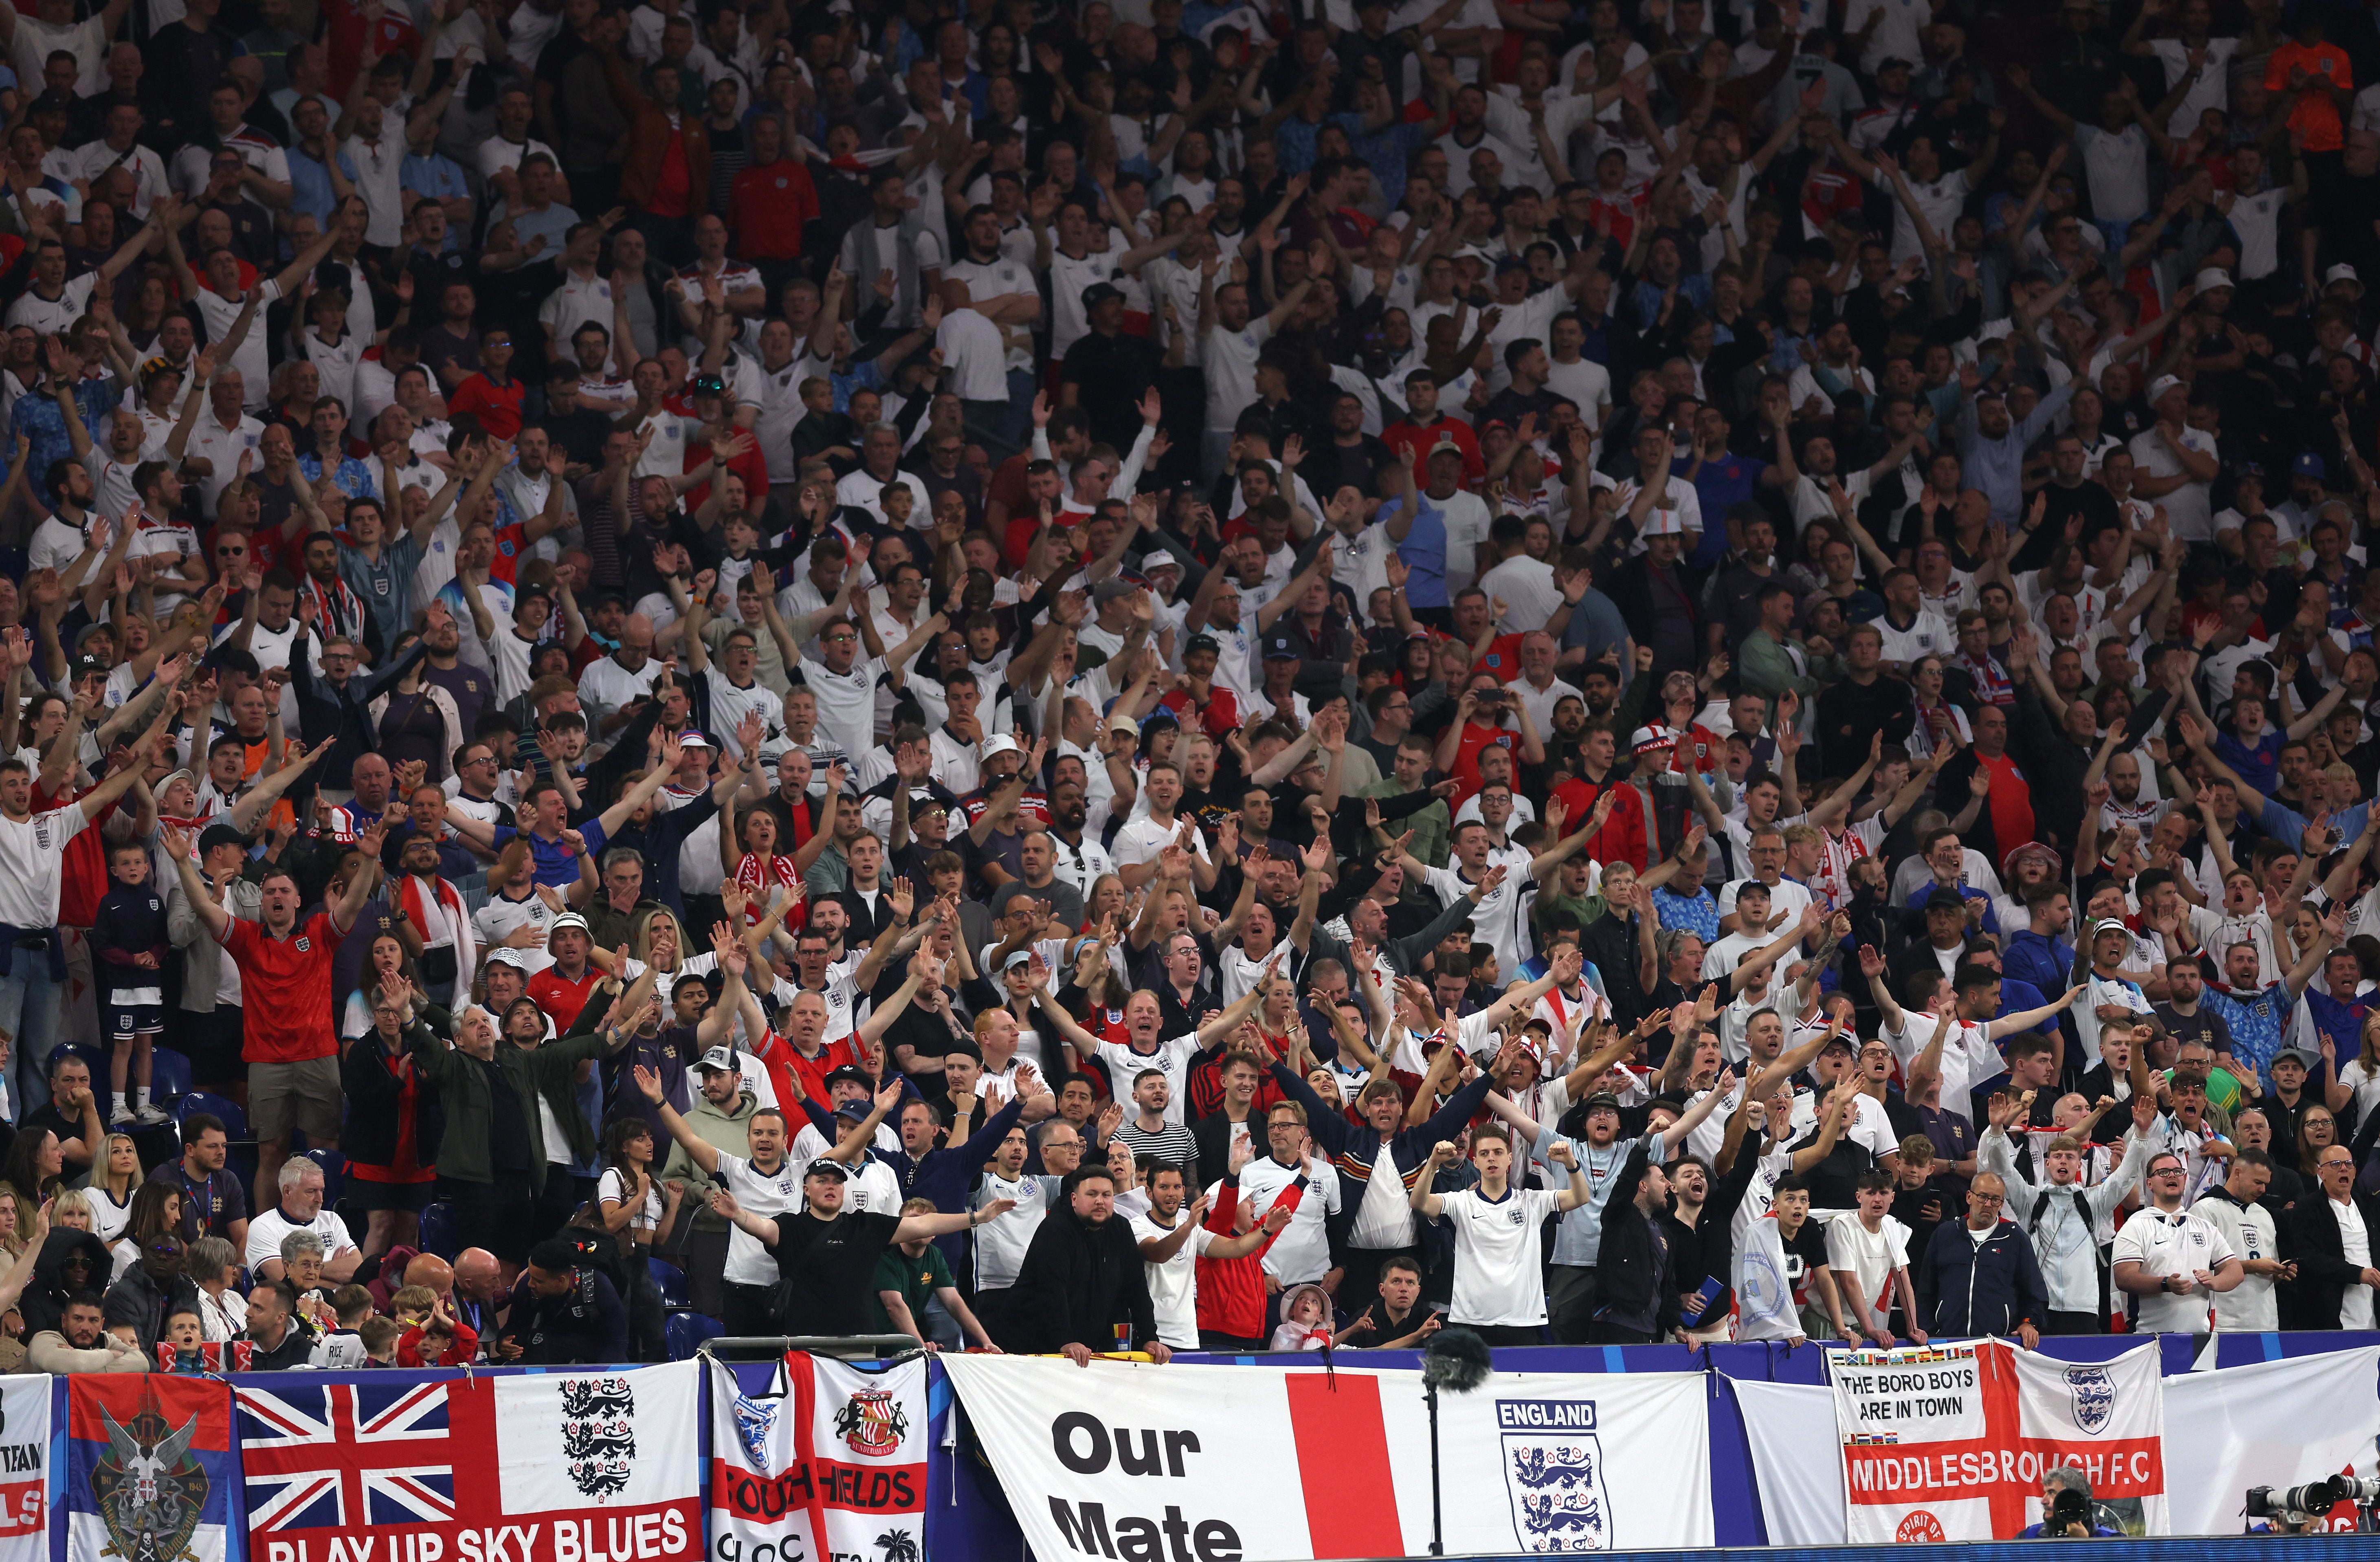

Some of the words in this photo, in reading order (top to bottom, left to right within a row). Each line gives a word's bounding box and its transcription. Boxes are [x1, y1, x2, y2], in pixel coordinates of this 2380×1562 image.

[1759, 1195, 1771, 1213] 9
[329, 1345, 343, 1358] RICE
[1842, 1376, 1874, 1394] THE
[1878, 1374, 1925, 1393] BORO
[1928, 1369, 1973, 1390] BOYS
[1501, 1404, 1594, 1426] ENGLAND
[1860, 1401, 1892, 1420] ARE
[1897, 1400, 1911, 1418] IN
[1916, 1397, 1962, 1417] TOWN
[852, 1442, 882, 1454] SUNDERLAND
[1051, 1411, 1201, 1477] Our
[101, 1476, 111, 1485] 1941
[1852, 1449, 2103, 1492] MIDDLESBROUGH
[189, 1483, 203, 1492] 1945
[389, 1533, 444, 1562] UP
[457, 1524, 541, 1562] SKY
[554, 1508, 688, 1562] BLUES
[1048, 1495, 1242, 1562] Mate
[1899, 1514, 1929, 1541] SPIRIT
[1929, 1522, 1941, 1539] OF
